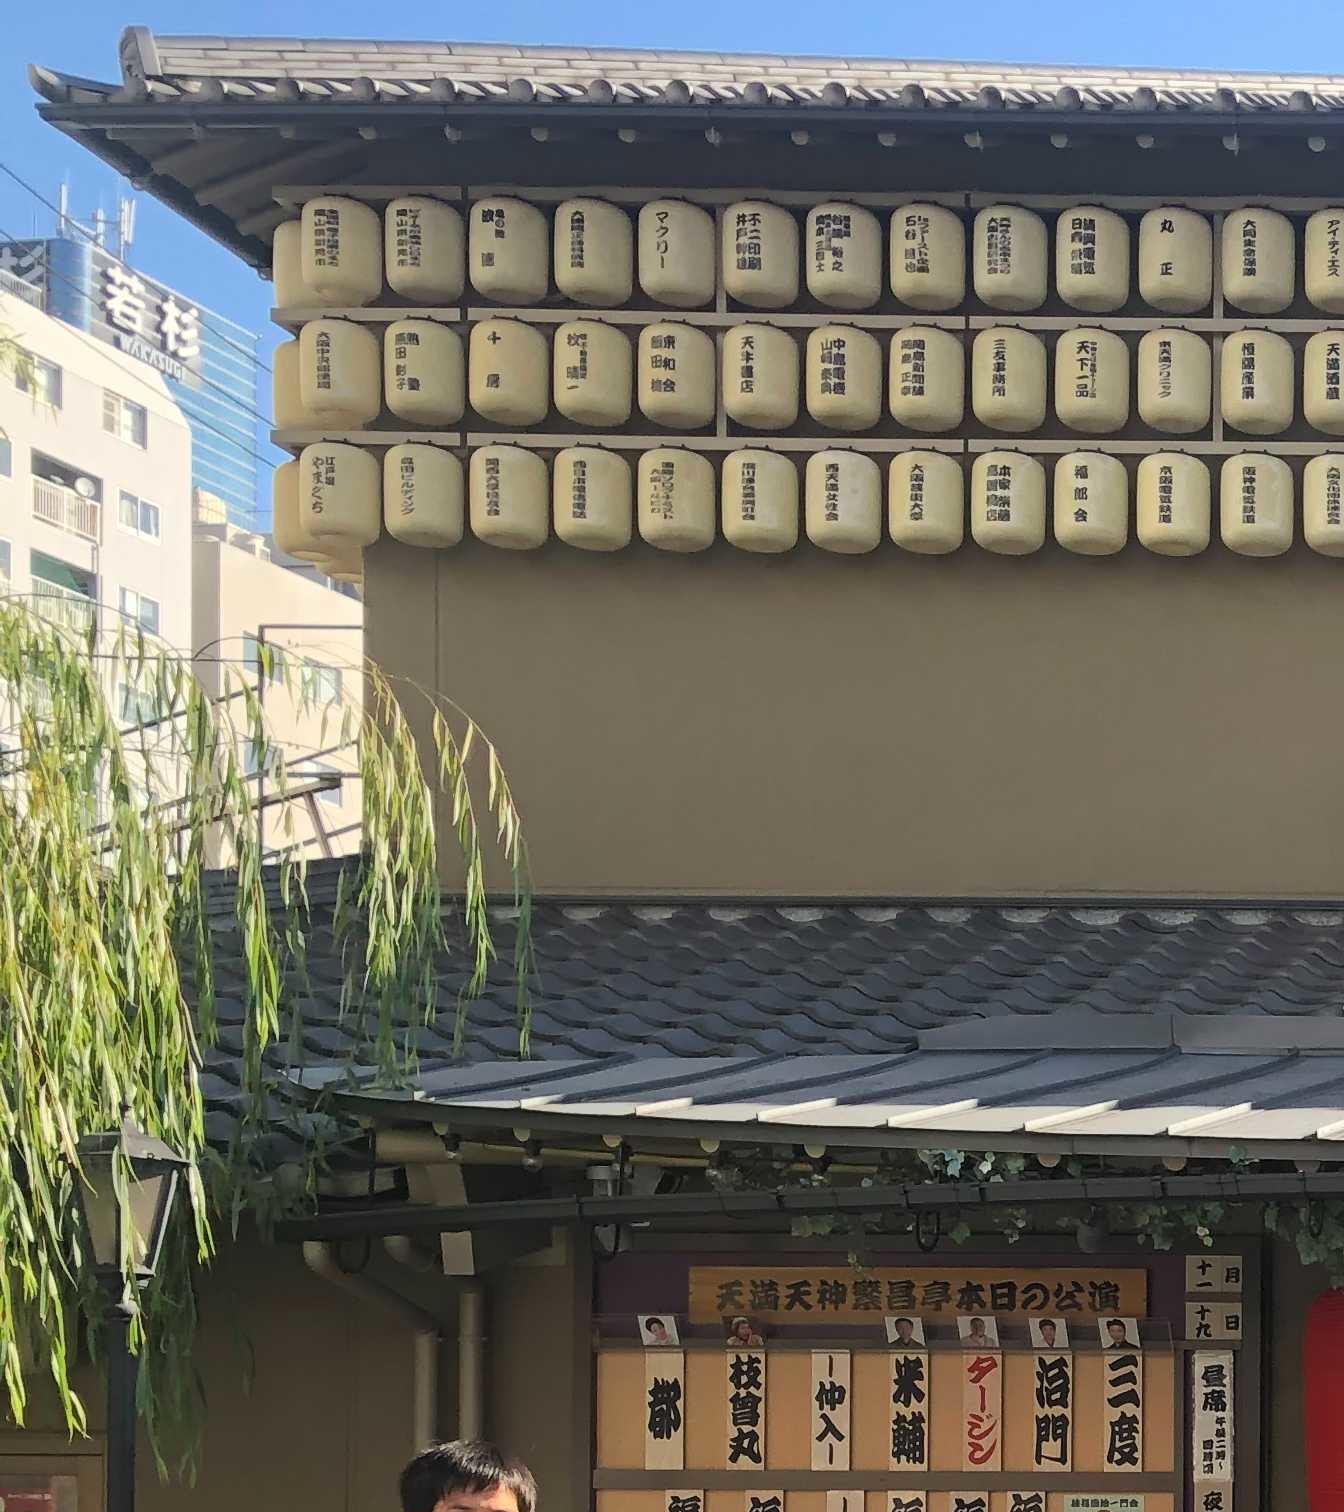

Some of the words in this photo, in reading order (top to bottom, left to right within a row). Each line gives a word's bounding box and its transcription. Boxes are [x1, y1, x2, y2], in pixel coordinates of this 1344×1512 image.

[656, 212, 669, 268] マクリー
[746, 213, 762, 271] 不二印刷
[104, 265, 200, 358] 若杉
[115, 333, 185, 384] WAKASUGI
[740, 336, 755, 394] 天牛書店
[1075, 340, 1091, 398] 天下一品
[1158, 465, 1173, 524] 京阪電気鉄道
[1242, 466, 1256, 524] 阪神電気鉄道
[716, 1280, 1121, 1312] 天満天神繁昌亭本日の公演
[893, 1356, 926, 1465] 米輔
[968, 1356, 998, 1466] タージン
[1107, 1354, 1141, 1466] 三度
[1201, 1364, 1228, 1412] 昼席
